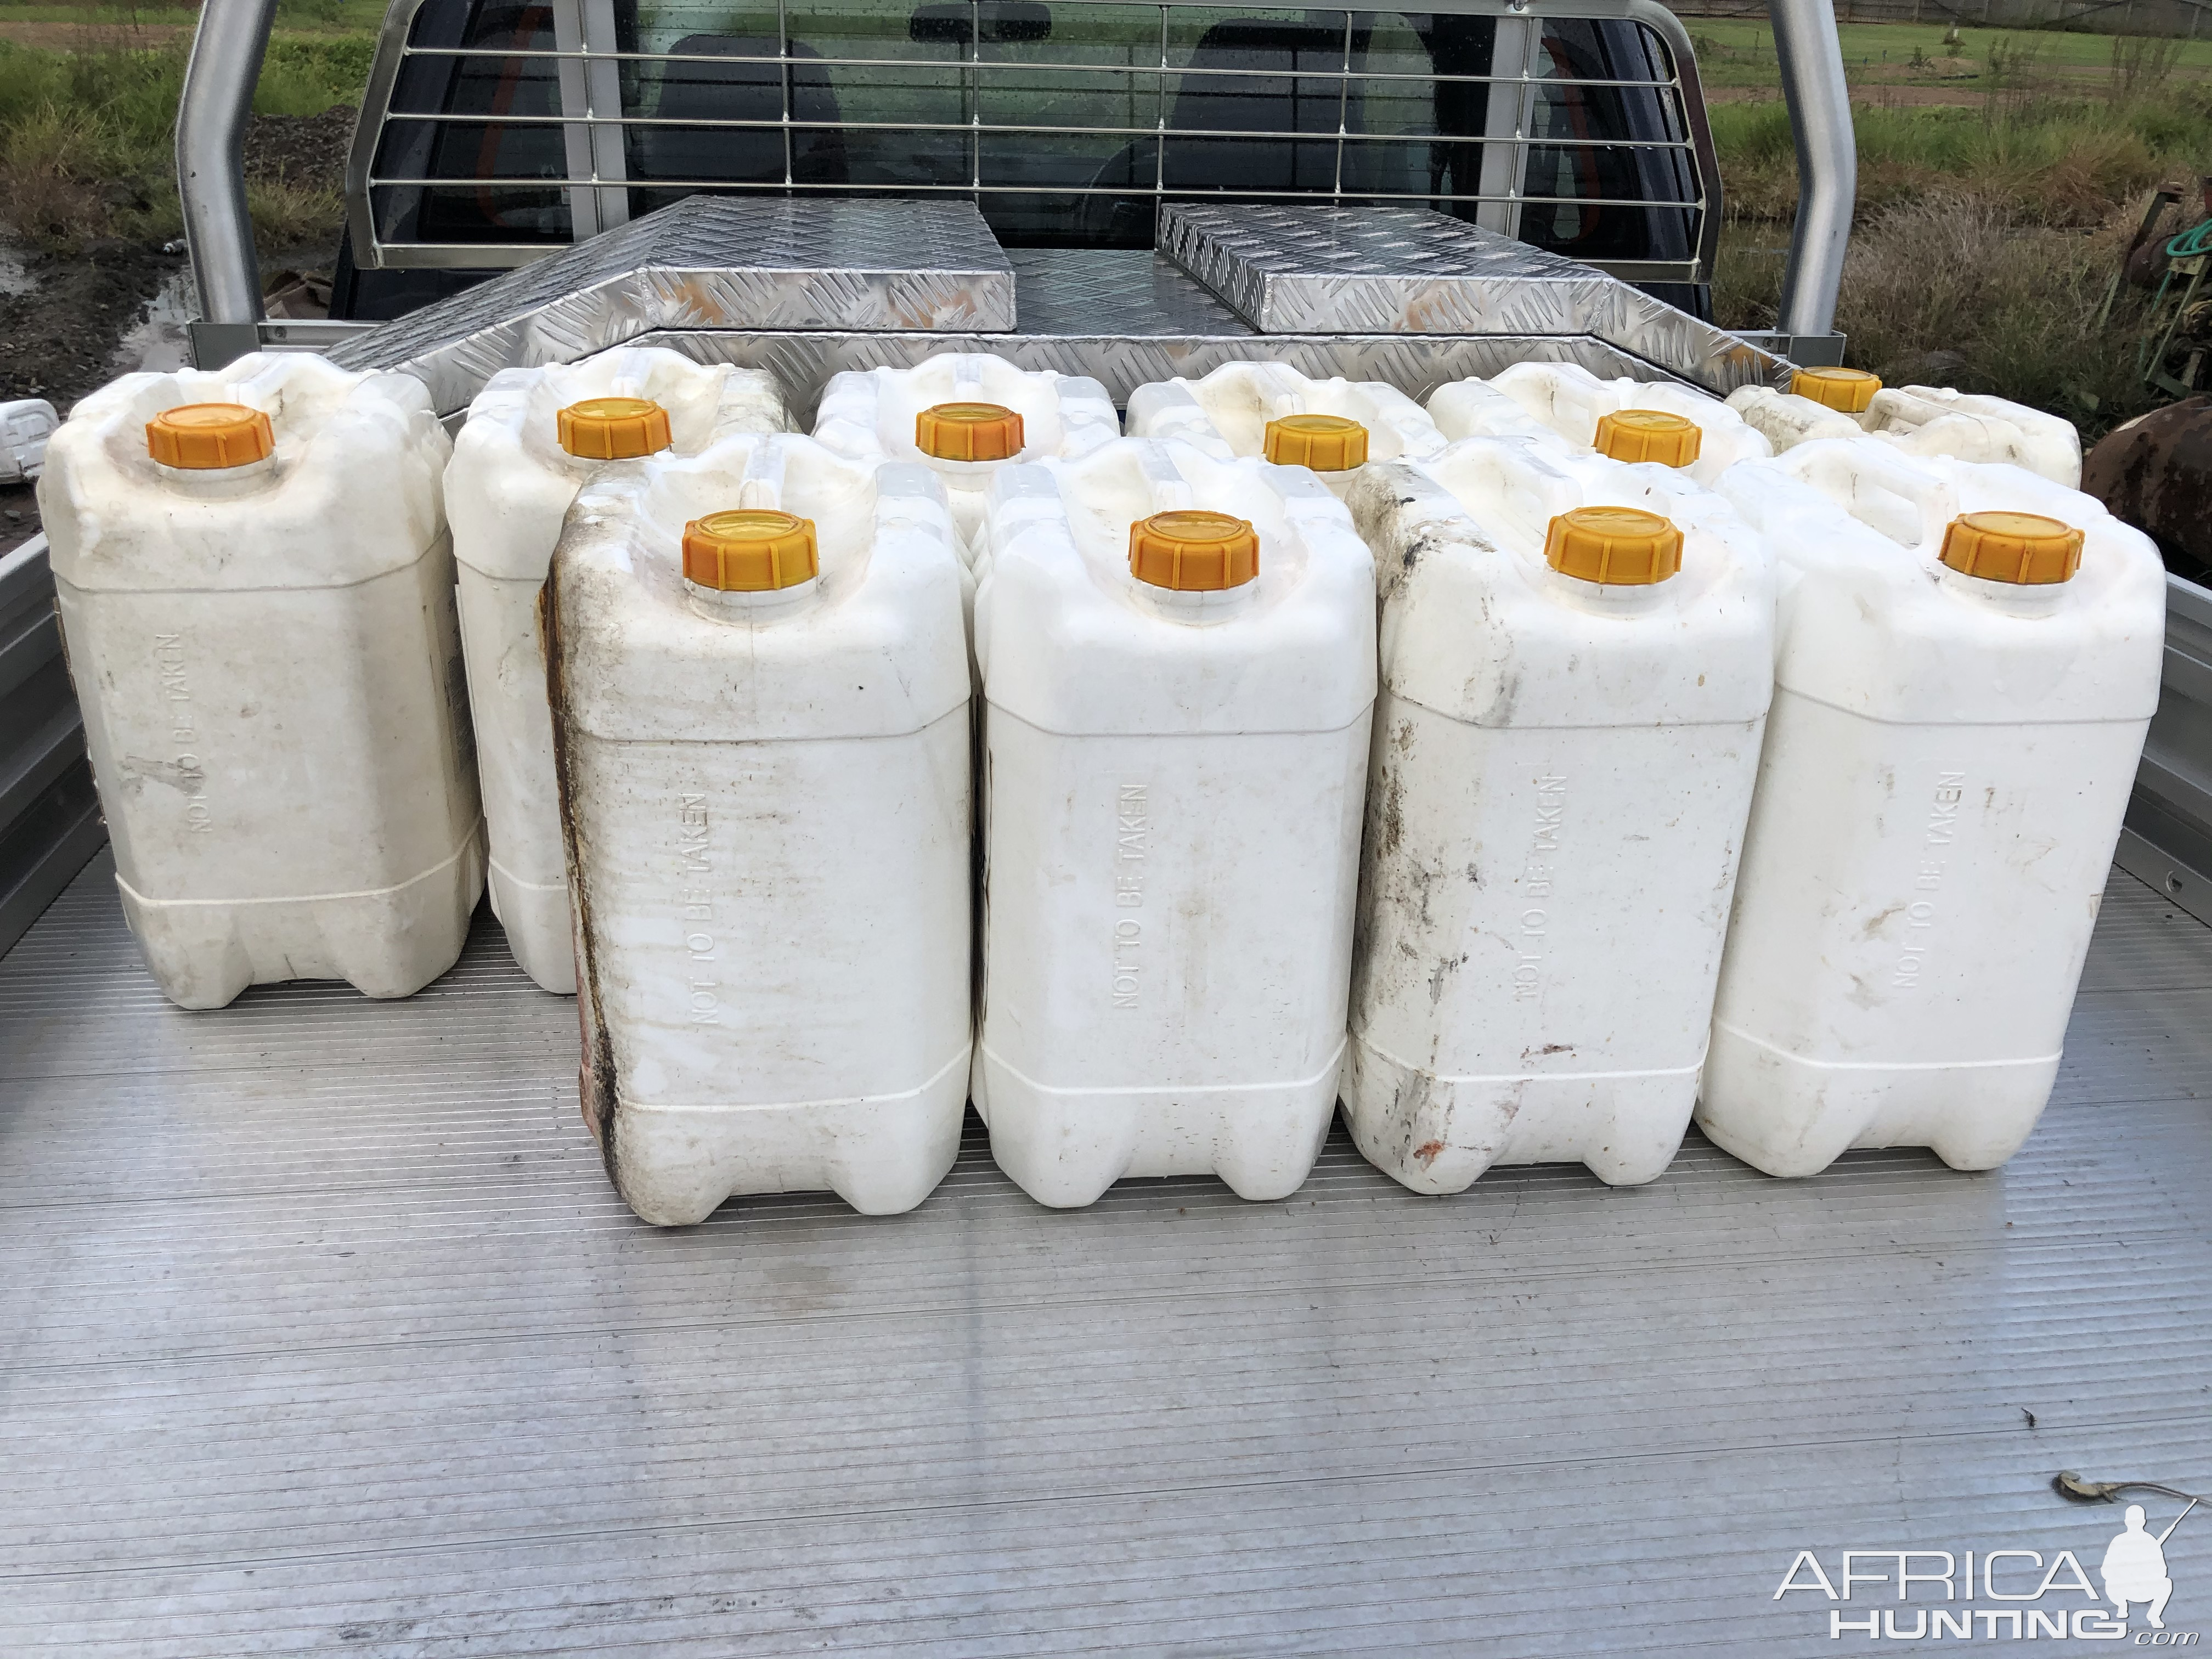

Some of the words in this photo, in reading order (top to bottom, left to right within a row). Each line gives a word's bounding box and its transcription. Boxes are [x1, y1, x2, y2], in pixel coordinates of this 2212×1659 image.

[184, 792, 212, 833] NOT
[1119, 785, 1147, 865] TAKEN
[1532, 776, 1567, 855] TAKEN
[1927, 772, 1966, 850] TAKEN
[678, 793, 711, 876] TAKEN
[1115, 876, 1144, 907] BE
[1526, 866, 1554, 898] BE
[1915, 860, 1946, 891] BE
[684, 889, 712, 921] BE
[1521, 909, 1547, 941] TO
[1907, 901, 1934, 932] TO
[686, 933, 715, 966] TO
[1114, 919, 1141, 951] TO
[1113, 962, 1139, 1009] NOT
[1512, 951, 1542, 997] NOT
[1892, 942, 1925, 988] NOT
[690, 977, 718, 1024] NOT
